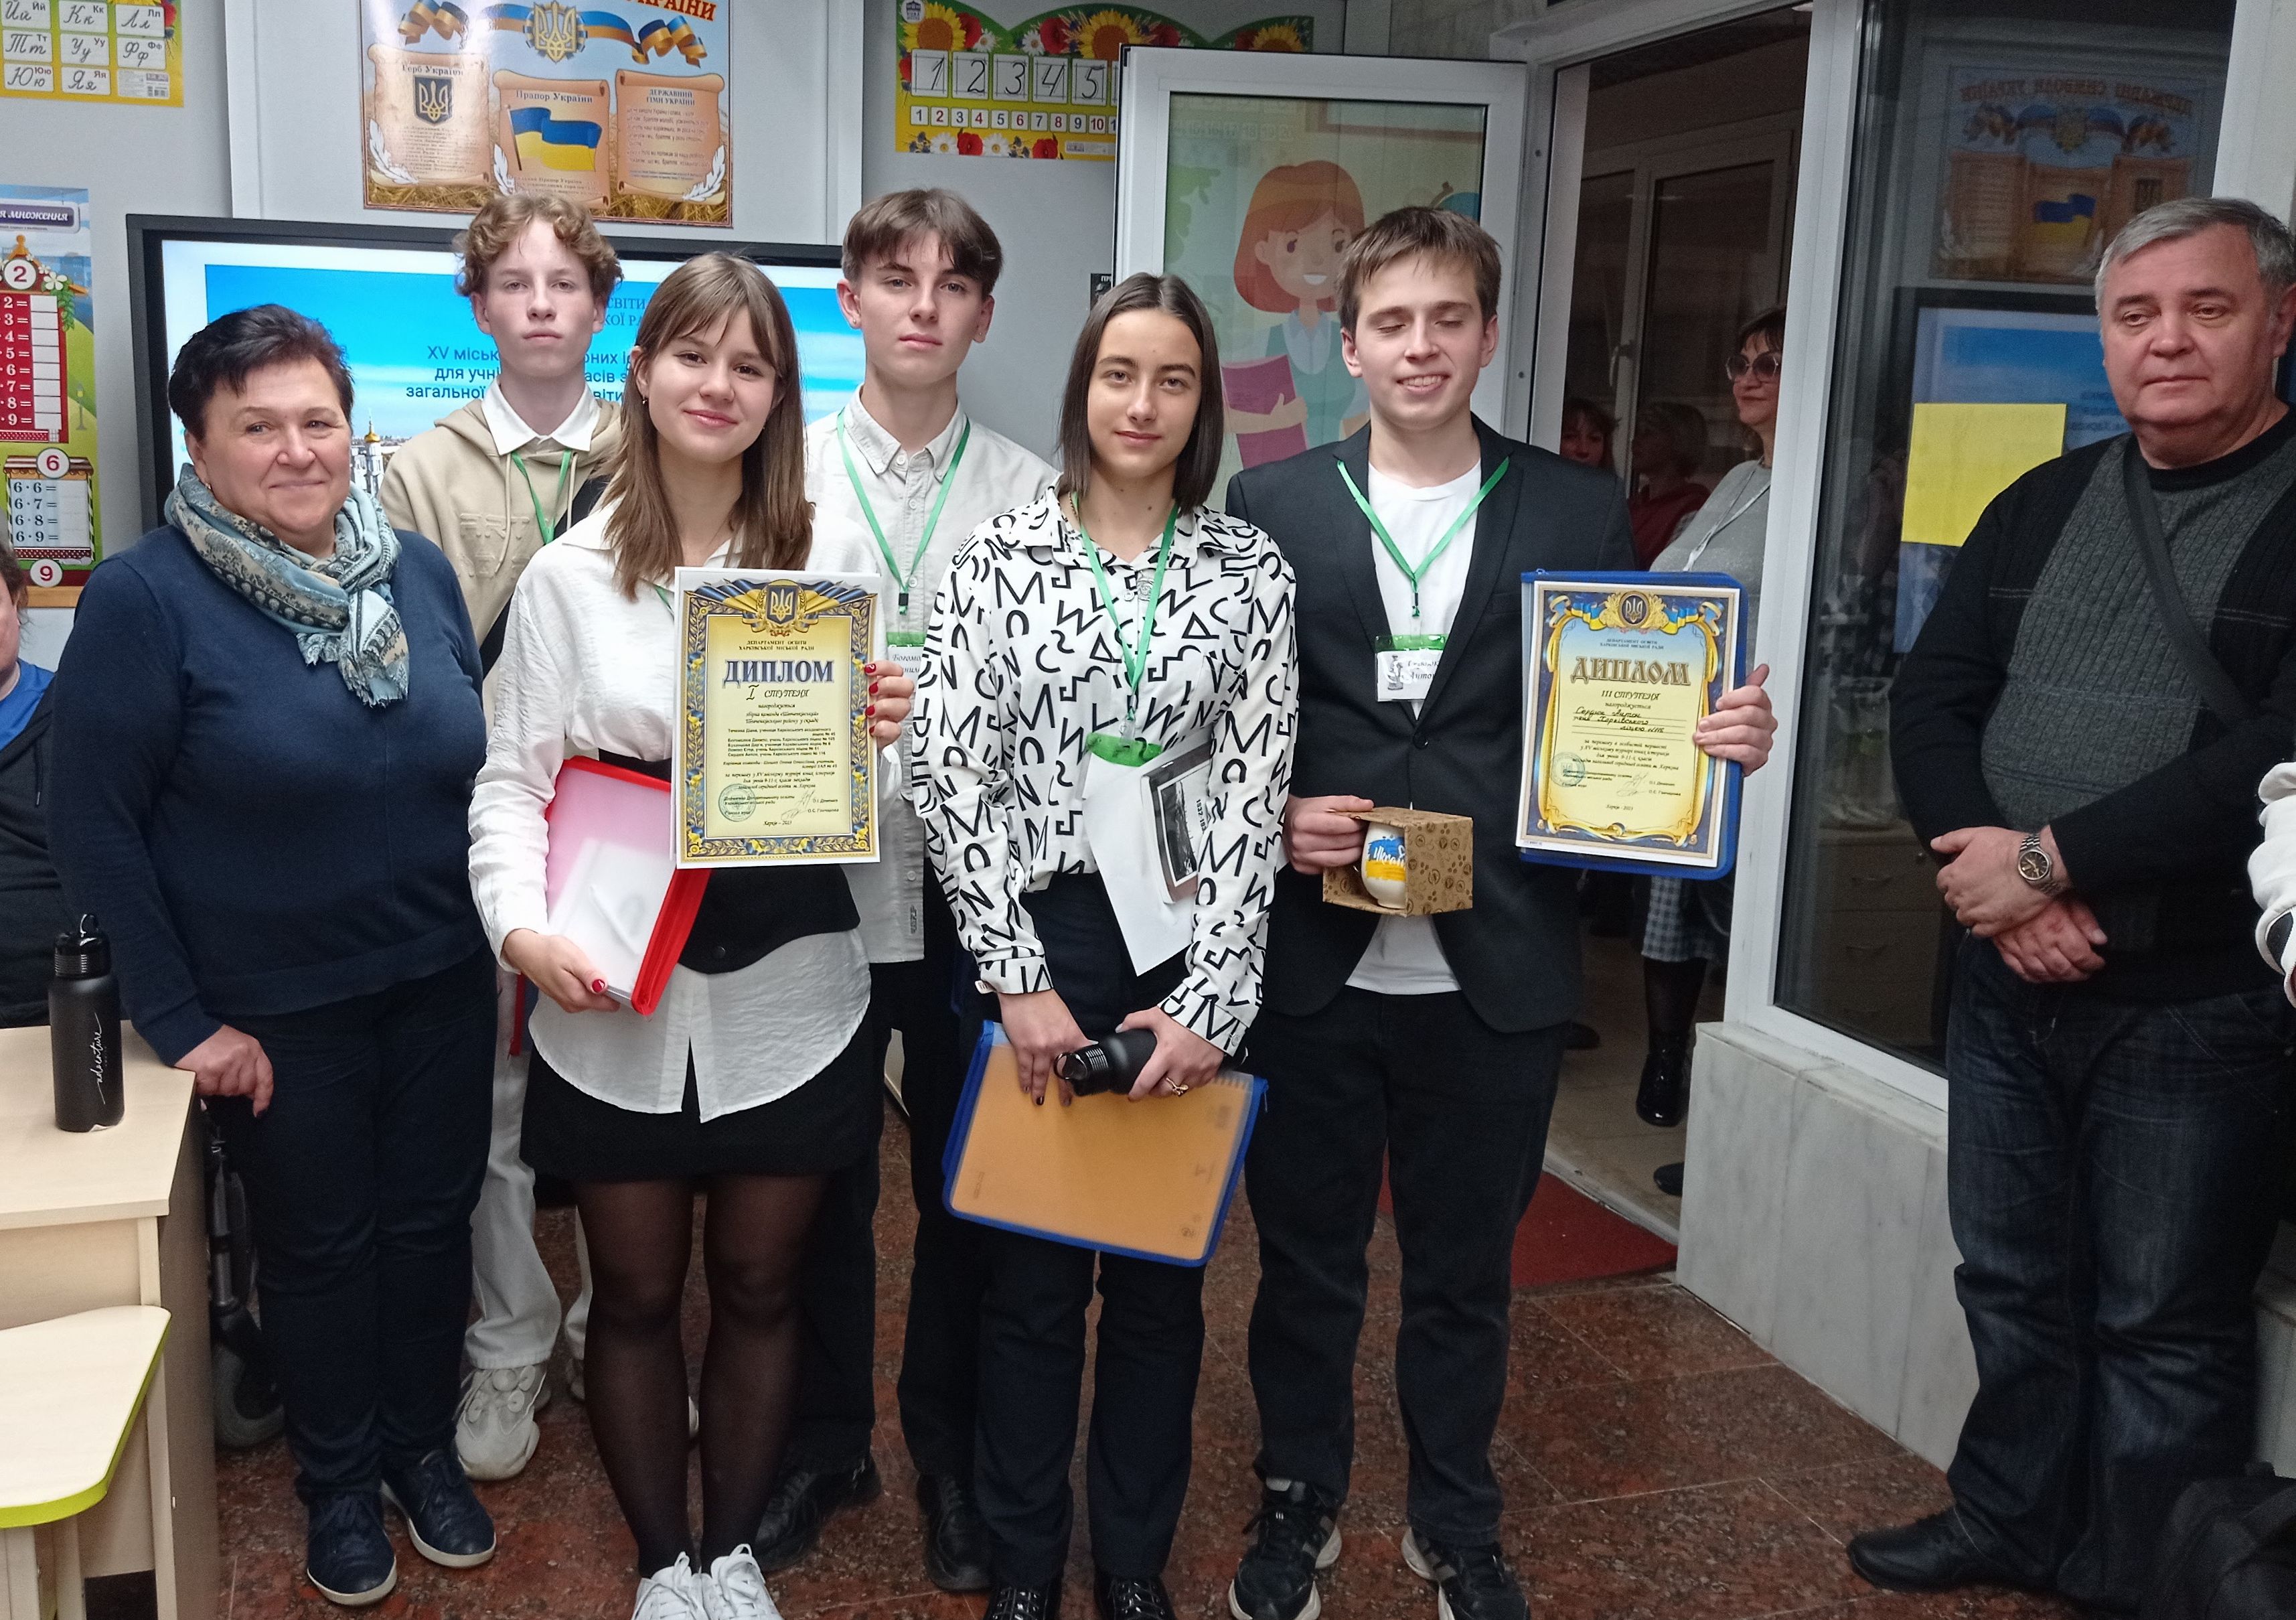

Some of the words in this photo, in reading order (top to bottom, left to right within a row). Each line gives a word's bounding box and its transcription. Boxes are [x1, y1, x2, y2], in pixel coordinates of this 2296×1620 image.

[932, 57, 945, 90] 1
[967, 60, 986, 92] 2
[1005, 62, 1026, 94] 3
[1041, 64, 1065, 96] 4
[1081, 66, 1105, 98] 5
[516, 90, 550, 102] Прапор
[553, 92, 593, 104] України
[649, 88, 692, 98] ДЕРЖАВНИЙ
[647, 97, 665, 105] ГІМН
[666, 98, 695, 106] УКРАЇНИ
[916, 109, 922, 121] 1
[936, 110, 944, 123] 2
[956, 111, 964, 123] 3
[975, 112, 983, 124] 4
[997, 113, 1004, 125] 5
[1016, 114, 1024, 127] 6
[1035, 115, 1043, 127] 7
[1054, 116, 1063, 128] 8
[1074, 117, 1082, 129] 9
[1091, 118, 1104, 131] 10
[8, 210, 68, 222] множення
[13, 265, 27, 283] 2
[435, 368, 464, 382] для
[406, 386, 485, 399] загальної
[46, 455, 60, 471] 6
[40, 565, 54, 581] 9
[722, 659, 835, 688] ДИПЛОМ
[1570, 656, 1691, 686] ДИПЛОМ
[764, 688, 810, 698] СТУПЕНЯ
[1614, 690, 1661, 701] СТУПЕНЯ
